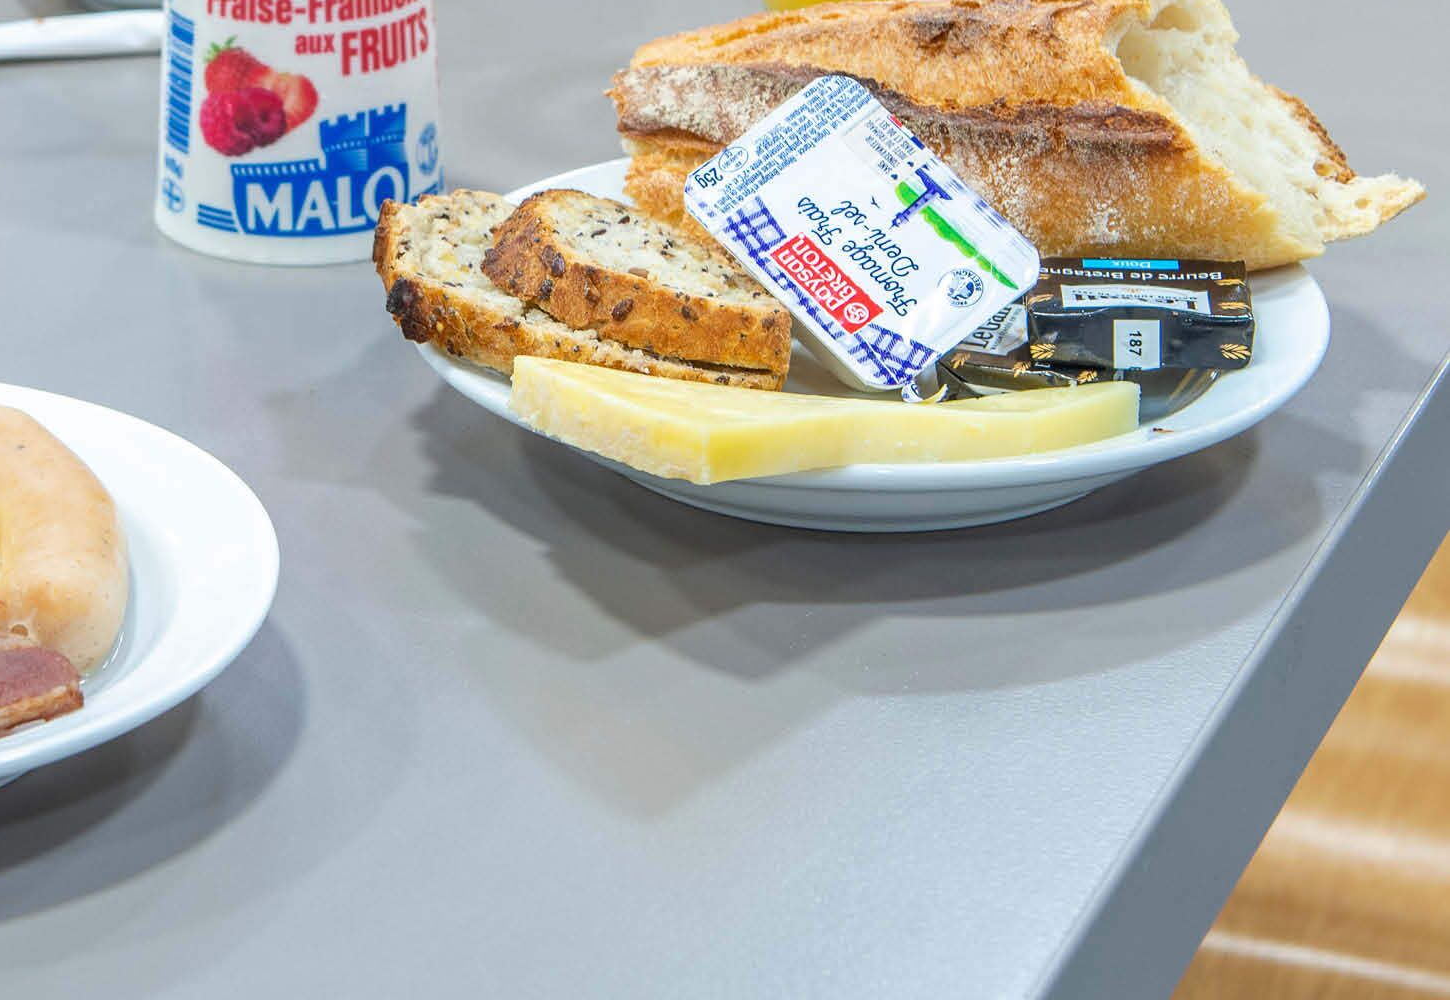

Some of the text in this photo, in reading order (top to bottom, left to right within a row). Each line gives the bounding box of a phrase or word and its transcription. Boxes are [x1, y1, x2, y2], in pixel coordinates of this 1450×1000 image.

[295, 7, 429, 76] aux FRUITS
[695, 168, 723, 188] 25g
[245, 166, 408, 233] MALO
[798, 197, 917, 316] Fromage Frais
[1111, 260, 1151, 268] Doux
[778, 248, 840, 312] paysan
[1130, 271, 1153, 281] de
[1158, 271, 1223, 281] Beurre
[1129, 330, 1142, 356] 187
